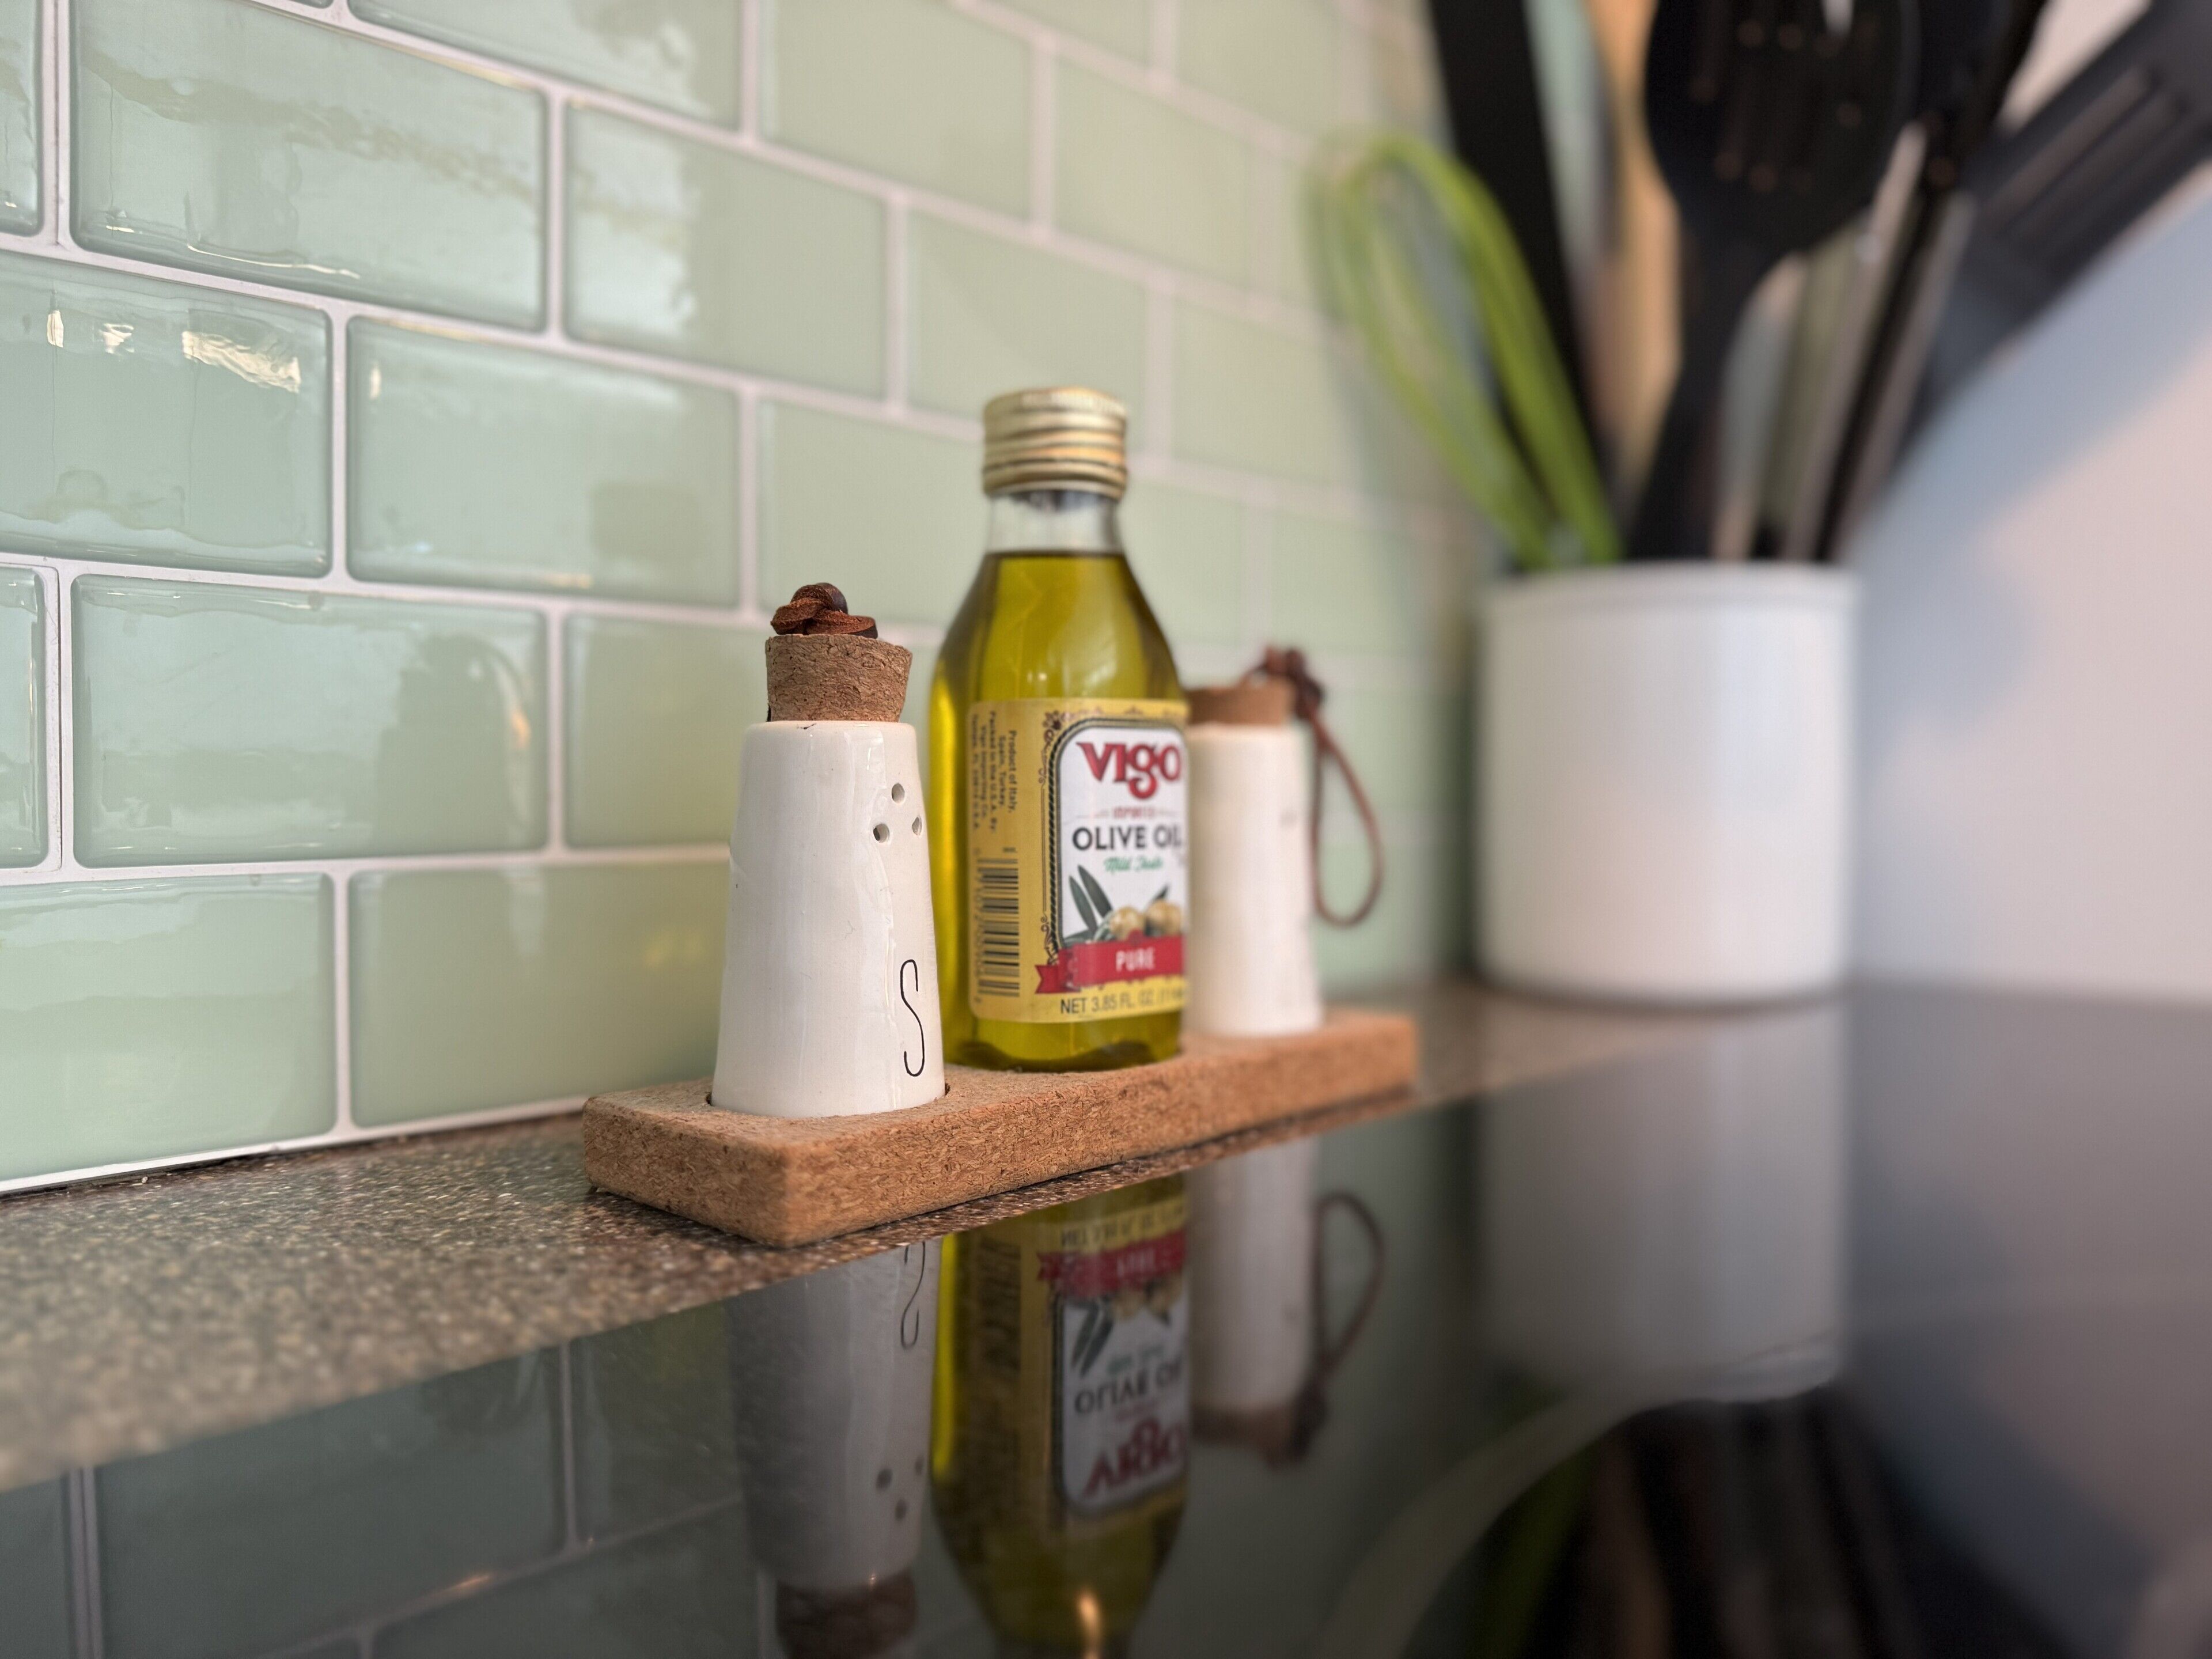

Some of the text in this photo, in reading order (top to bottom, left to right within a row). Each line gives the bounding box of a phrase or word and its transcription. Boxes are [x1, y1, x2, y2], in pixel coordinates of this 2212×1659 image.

[1008, 730, 1017, 770] Product
[1072, 826, 1147, 851] OLIVE
[1115, 946, 1156, 972] PURE
[1060, 997, 1087, 1014] NET
[1091, 994, 1118, 1012] 3.85
[900, 959, 925, 1077] S
